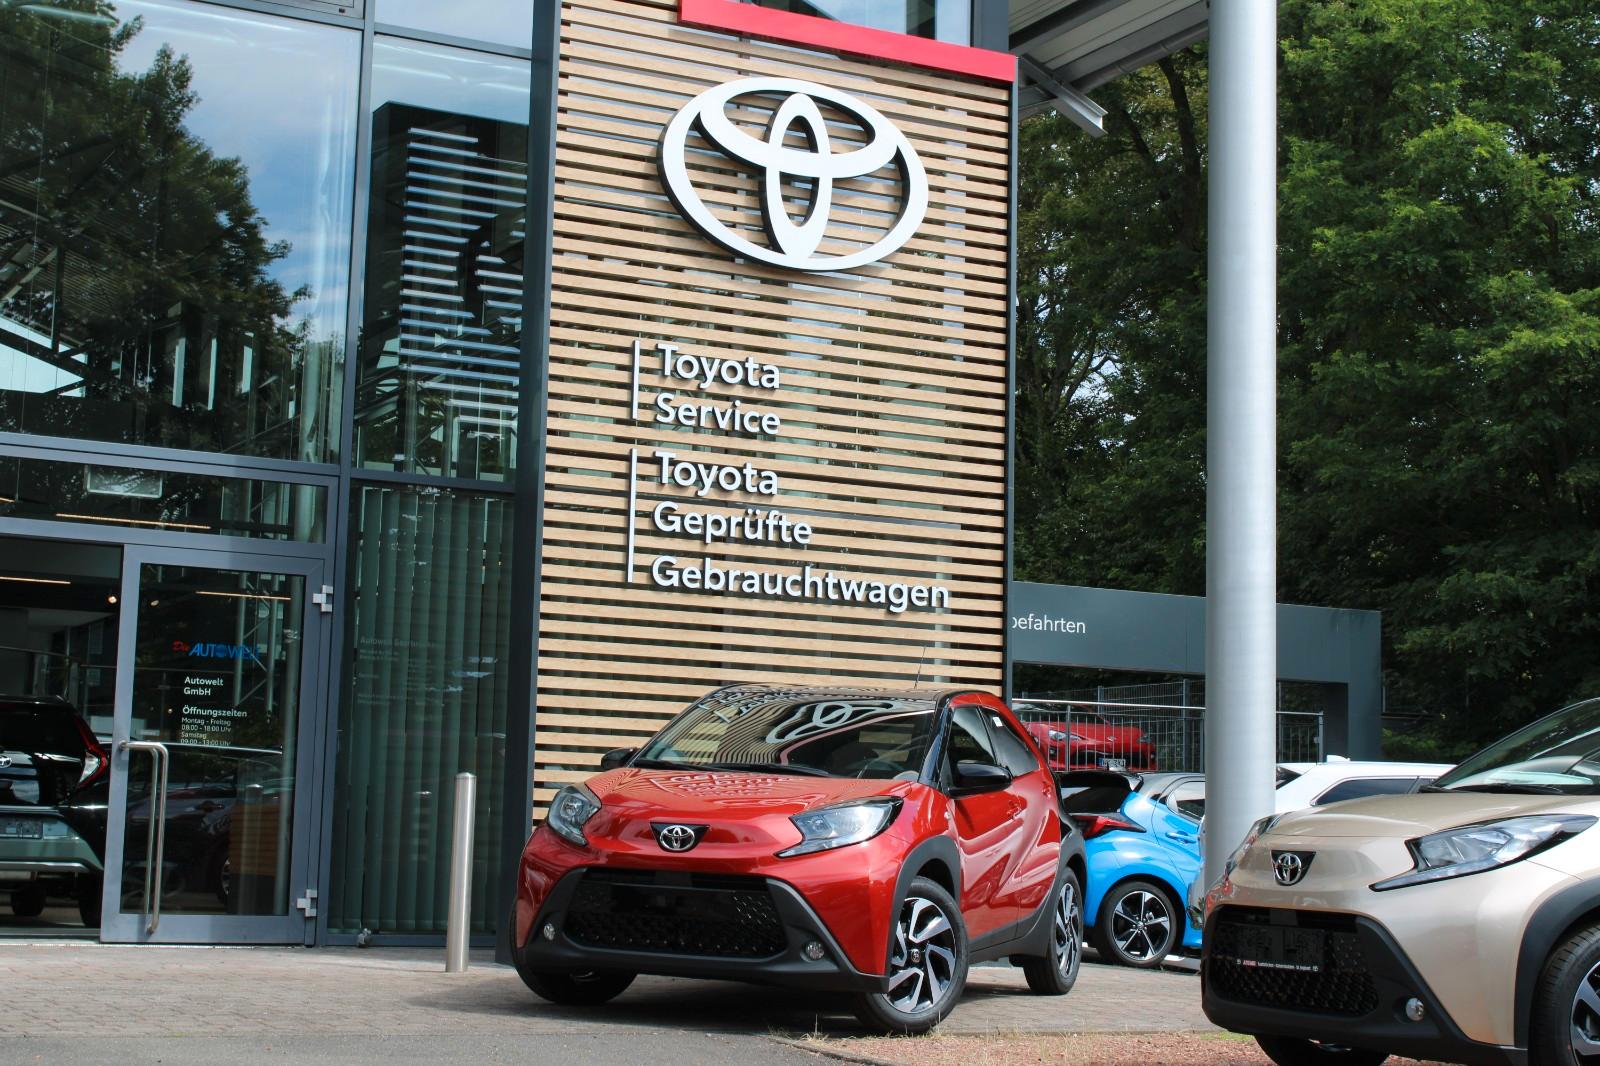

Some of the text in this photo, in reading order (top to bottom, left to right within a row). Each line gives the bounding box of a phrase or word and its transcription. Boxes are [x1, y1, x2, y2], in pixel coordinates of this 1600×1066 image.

[655, 342, 781, 390] Toyota
[655, 392, 781, 435] Service
[653, 450, 779, 496] Toyota
[653, 501, 813, 544] Geprüfte
[652, 555, 949, 613] Gebrauchtwagen
[183, 687, 211, 696] GmbH
[184, 676, 224, 686] Autowelt
[182, 705, 248, 718] Öffnungszeiten
